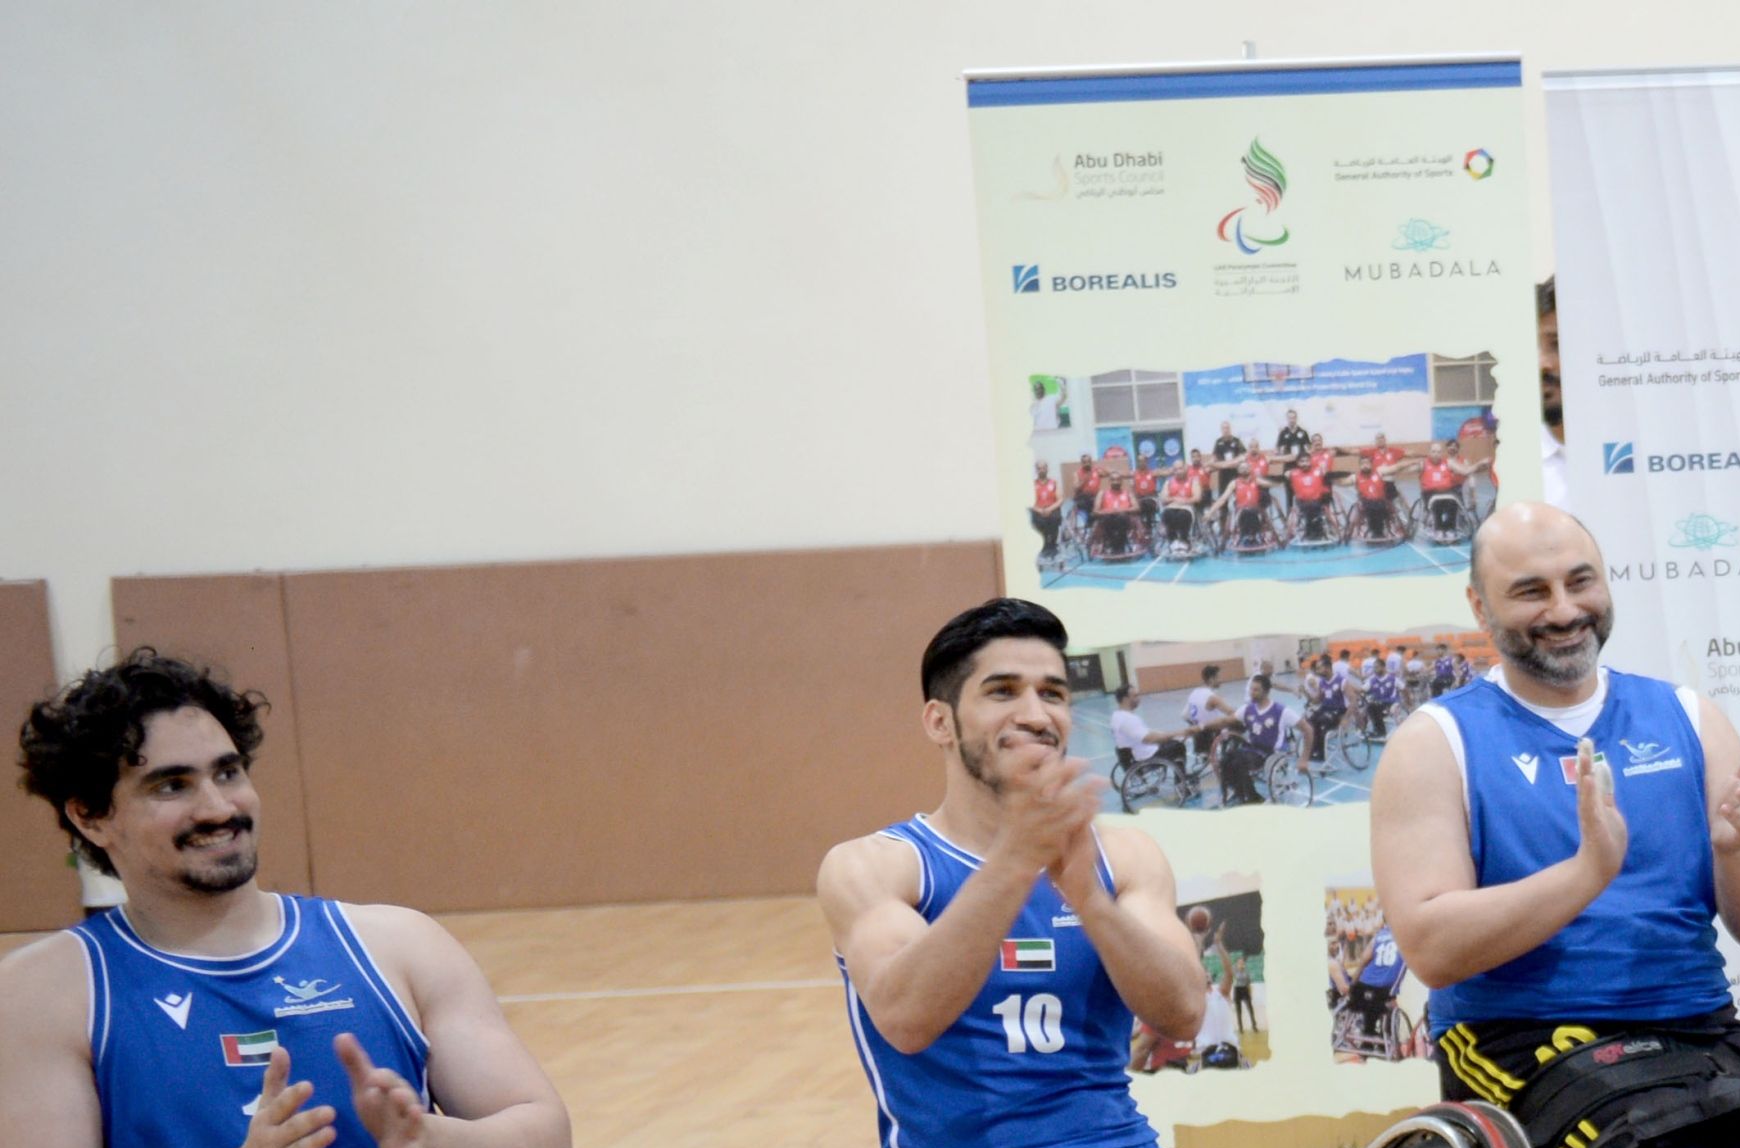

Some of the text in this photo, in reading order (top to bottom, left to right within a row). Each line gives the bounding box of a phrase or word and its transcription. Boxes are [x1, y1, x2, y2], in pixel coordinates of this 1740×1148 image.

[1074, 151, 1163, 168] Abu Dhabi
[1344, 259, 1502, 282] MUBADALA
[1052, 272, 1177, 292] BOREALIS
[1599, 373, 1642, 387] General
[1647, 371, 1698, 386] Authority
[1701, 371, 1711, 383] of
[992, 993, 1066, 1054] 10
